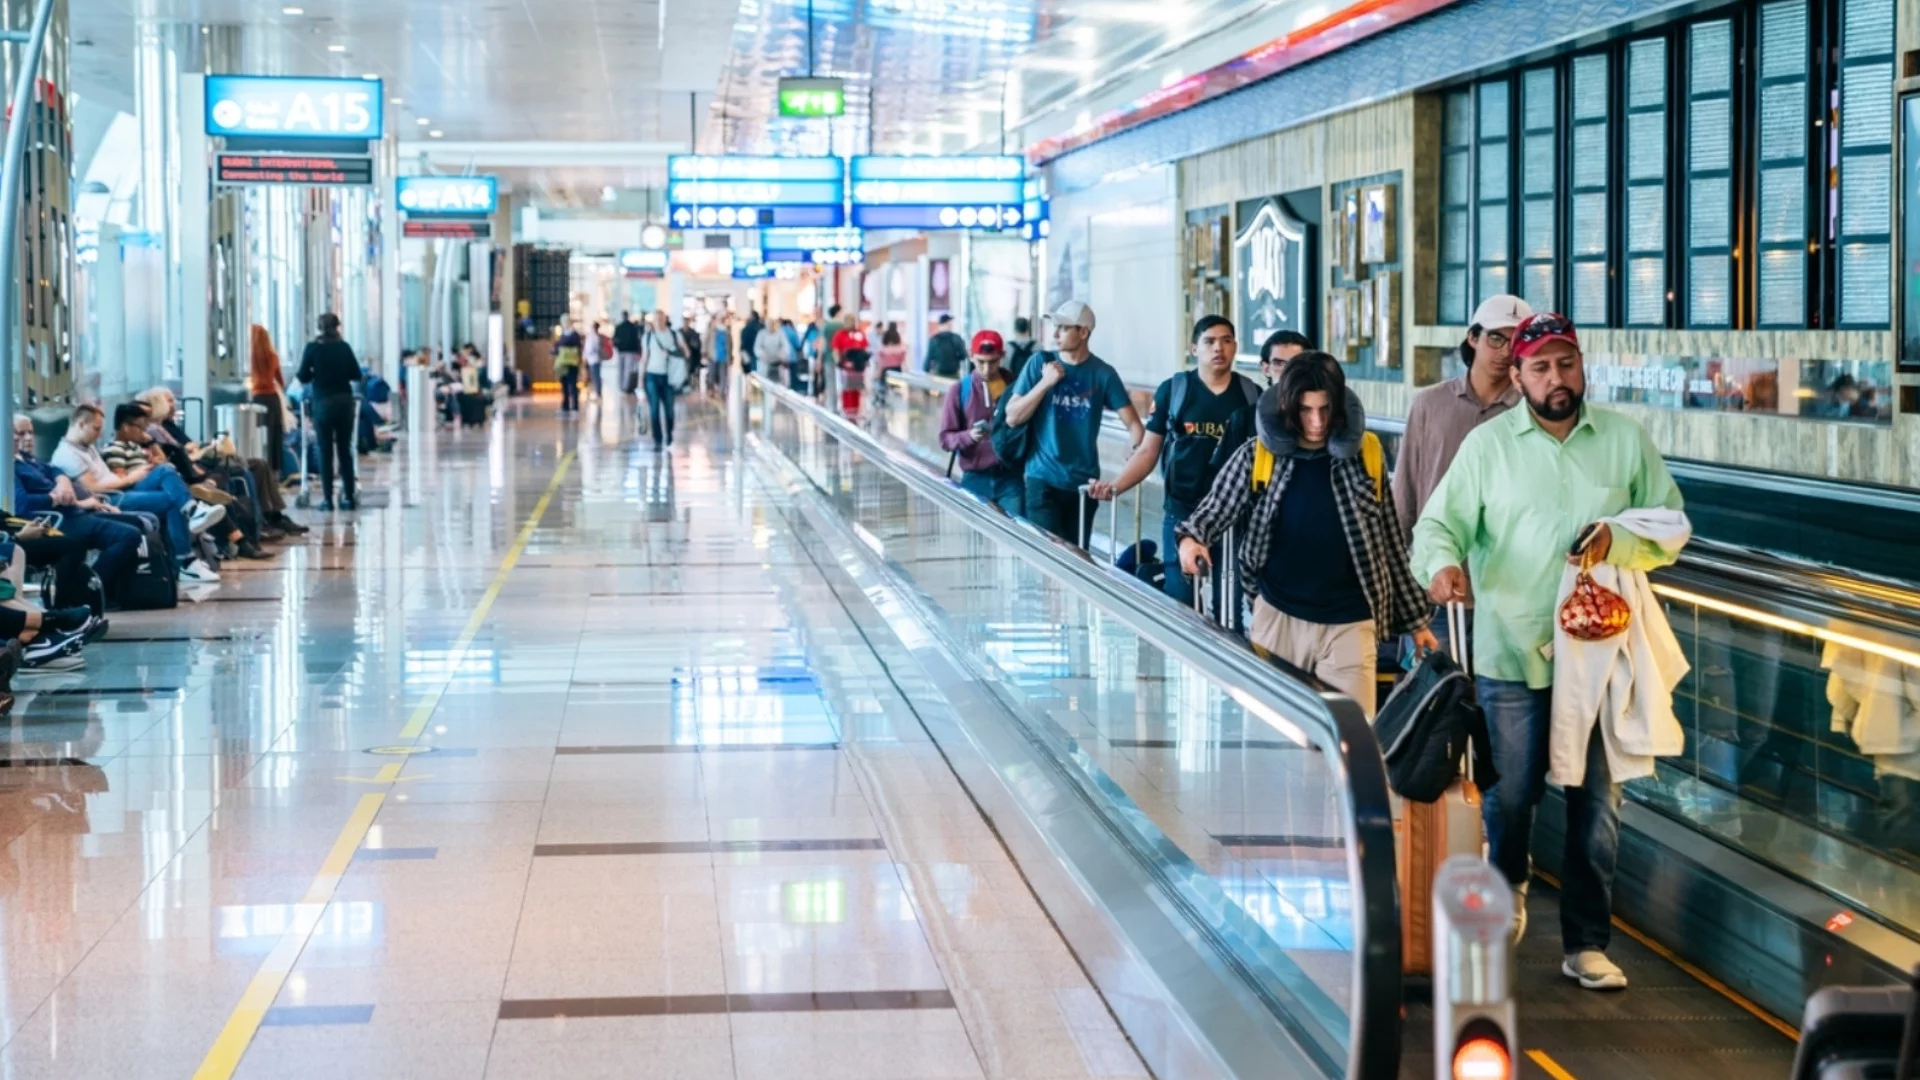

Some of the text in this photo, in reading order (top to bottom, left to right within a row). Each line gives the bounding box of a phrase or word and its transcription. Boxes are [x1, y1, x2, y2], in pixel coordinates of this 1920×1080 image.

[284, 91, 369, 132] A15
[221, 157, 337, 169] DUBAI INTERNATIONAL
[221, 169, 345, 183] Connecting the World
[440, 184, 493, 208] A14
[1052, 393, 1091, 409] NASA
[1183, 421, 1226, 436] DUBA
